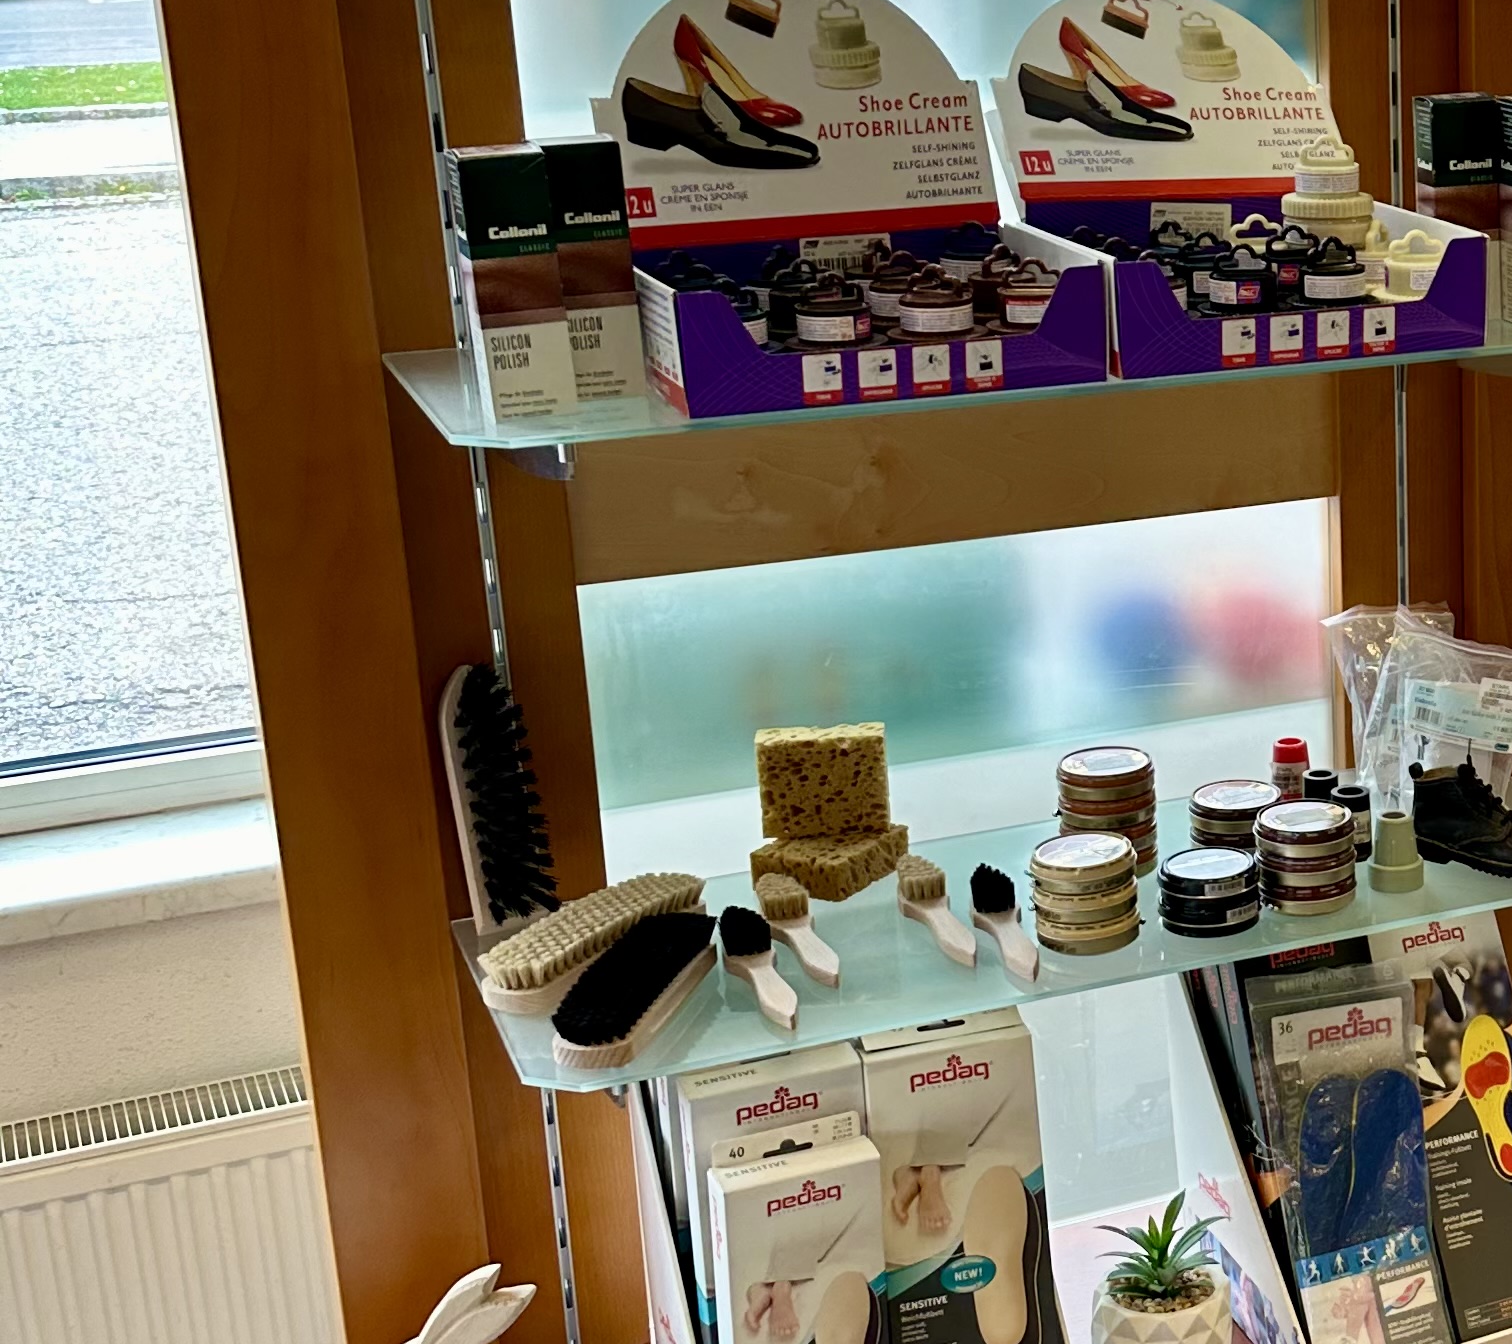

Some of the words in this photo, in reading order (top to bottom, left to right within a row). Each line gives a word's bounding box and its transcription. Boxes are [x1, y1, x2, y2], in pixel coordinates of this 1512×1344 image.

[859, 95, 904, 113] Shoe
[908, 92, 969, 111] Cream
[1222, 86, 1262, 102] Shoe
[1265, 86, 1317, 102] Cream
[1190, 106, 1326, 121] AUTOBRILLANTE
[817, 115, 975, 141] AUTOBRILLANTE
[911, 141, 976, 154] SELF-SHINING
[893, 157, 945, 171] ZELFGLANS
[1024, 156, 1041, 173] 12
[1042, 159, 1052, 173] u
[1449, 158, 1493, 172] Collonil
[917, 172, 982, 184] SELBSTGLANZ
[905, 185, 984, 199] AUTOBRILHANTE
[642, 199, 654, 214] u
[563, 209, 621, 226] Collonil
[487, 223, 548, 241] Collonil
[490, 333, 532, 353] SILICON
[493, 352, 531, 371] POLISH
[1401, 925, 1465, 954] pedag
[1277, 1021, 1294, 1036] 36
[1307, 1016, 1393, 1051] pedag
[694, 1068, 759, 1088] SENSITIVE
[909, 1062, 990, 1094] pedag
[736, 1089, 820, 1126] pedag
[1425, 1129, 1480, 1150] PERFORMANCE
[728, 1145, 746, 1160] 40
[724, 1159, 790, 1179] SENSITIVE
[766, 1183, 842, 1218] pedag
[954, 1266, 984, 1282] NEW!
[1376, 1259, 1431, 1282] PERFORMANCE
[899, 1294, 949, 1313] SENSITIVE
